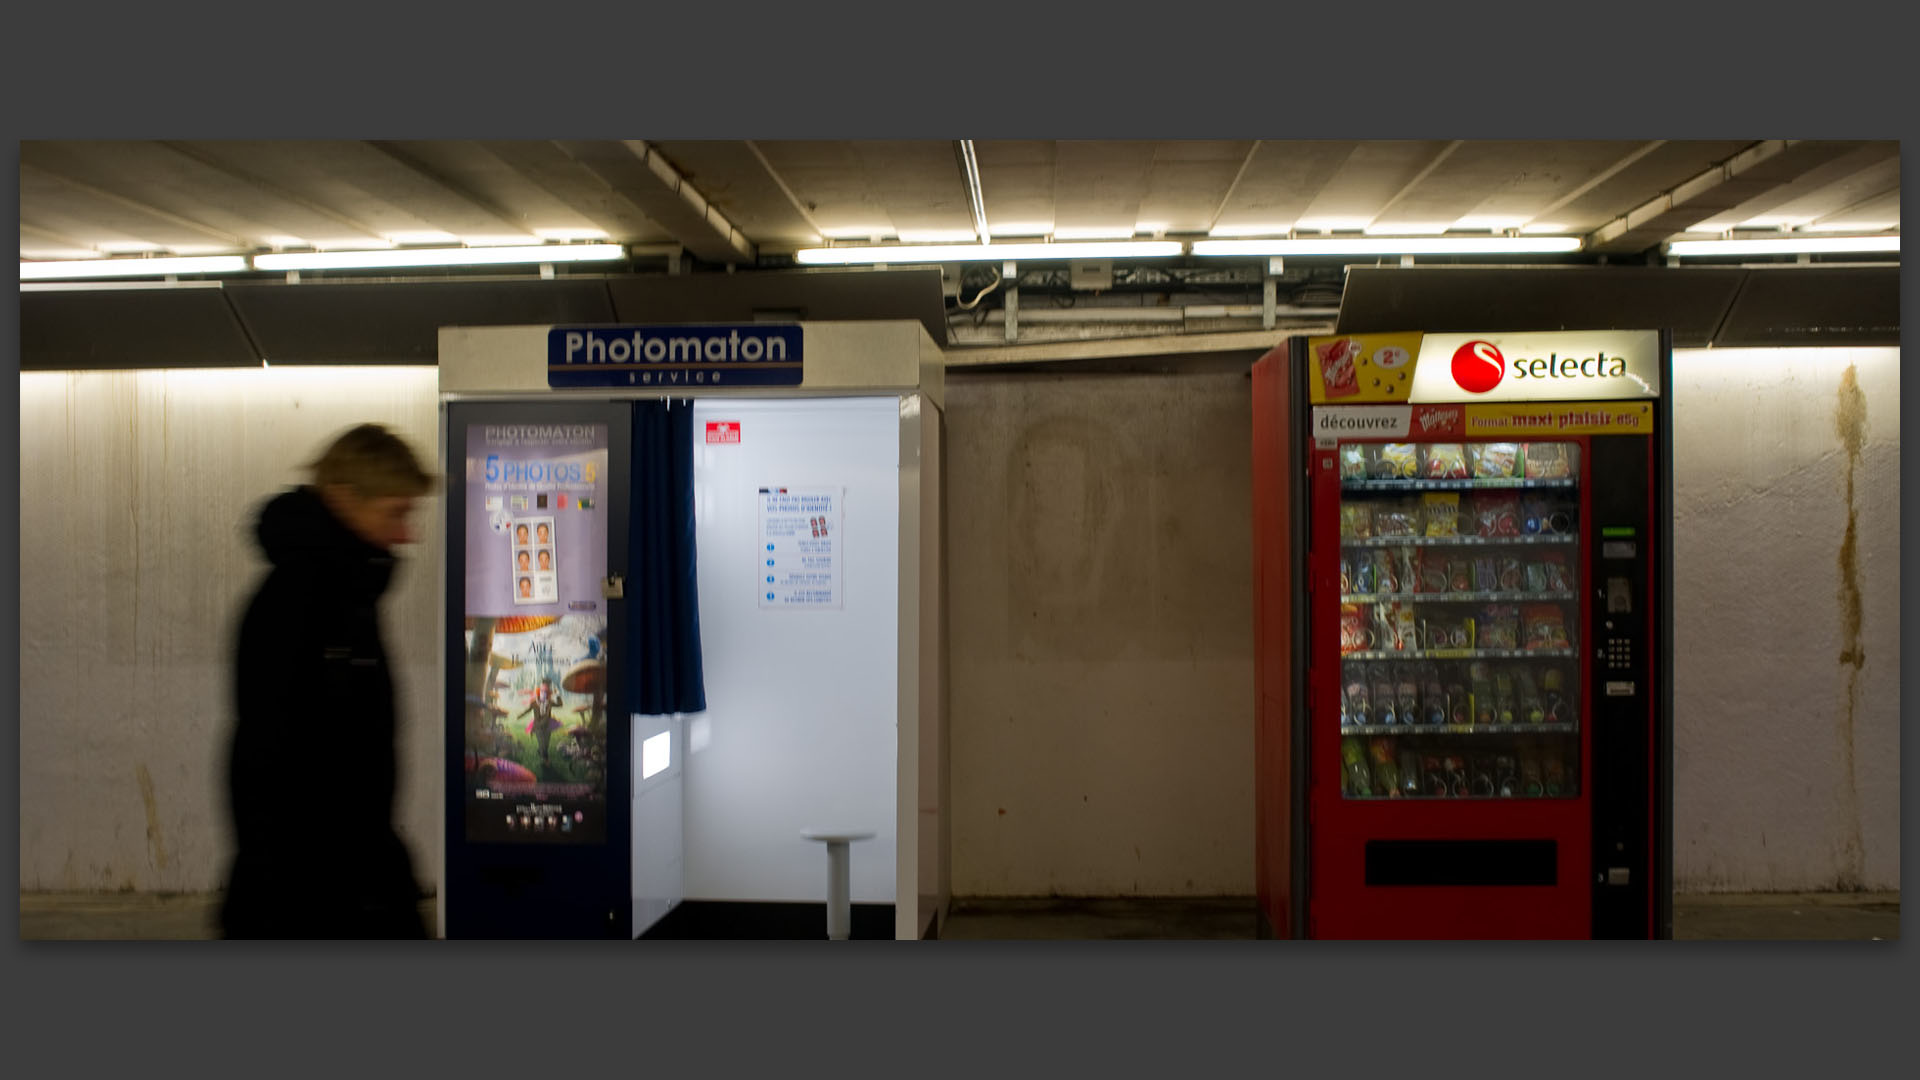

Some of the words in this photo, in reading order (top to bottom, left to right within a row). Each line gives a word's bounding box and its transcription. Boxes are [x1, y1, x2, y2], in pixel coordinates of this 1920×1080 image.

[565, 330, 787, 363] Photomaton
[629, 369, 721, 384] service
[1513, 352, 1627, 379] selecta
[1320, 413, 1398, 429] découvrez
[1511, 411, 1554, 428] maxi
[1558, 409, 1611, 430] plaisir
[485, 425, 595, 440] PHOTOMATON
[485, 454, 499, 483] 5
[503, 463, 581, 482] PHOTOS
